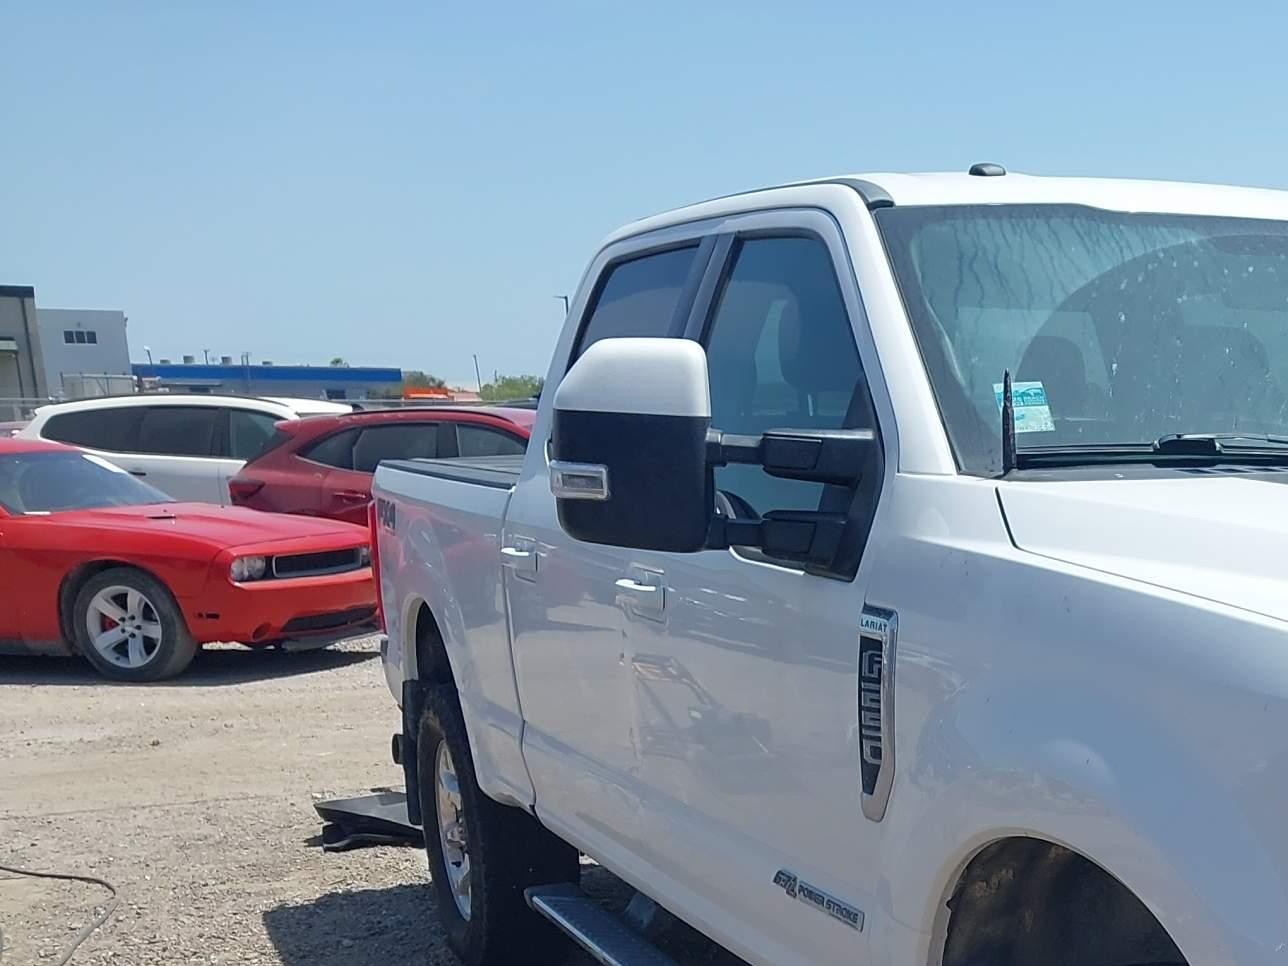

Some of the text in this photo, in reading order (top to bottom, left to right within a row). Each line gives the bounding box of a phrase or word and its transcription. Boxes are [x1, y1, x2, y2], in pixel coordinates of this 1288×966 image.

[860, 617, 888, 632] LARIAT
[798, 884, 825, 908] POWER
[825, 898, 860, 924] STROKE
